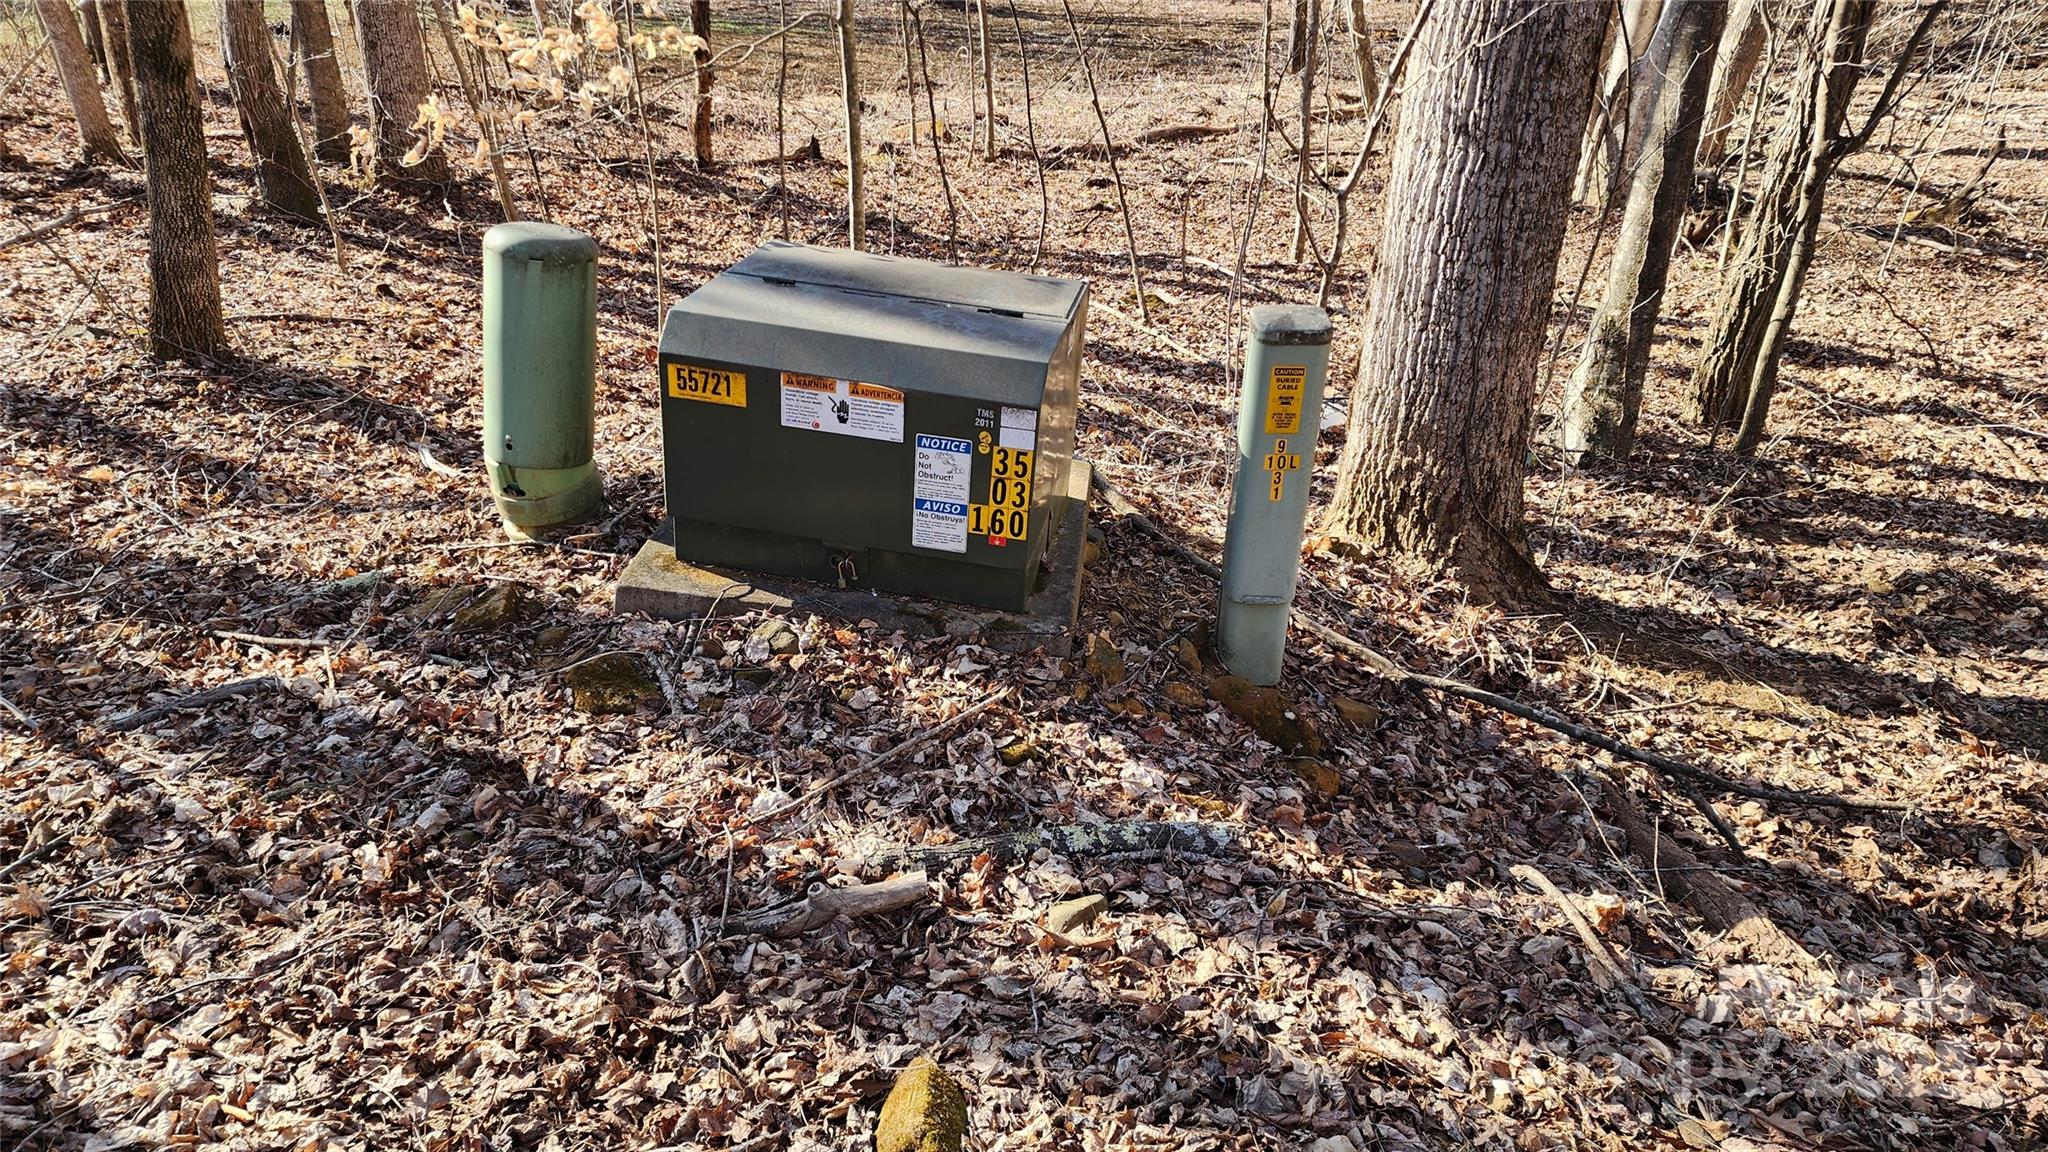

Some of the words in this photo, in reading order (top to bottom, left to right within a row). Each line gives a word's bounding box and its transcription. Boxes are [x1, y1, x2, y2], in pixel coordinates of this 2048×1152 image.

[676, 368, 731, 397] 55721
[795, 379, 834, 391] WARNING
[860, 388, 902, 401] ADVERTENCIA
[977, 408, 995, 419] TMS
[975, 418, 994, 428] 2011
[921, 437, 967, 453] NOTICE
[918, 453, 930, 461] Do
[918, 462, 932, 470] Not
[918, 471, 954, 481] Obstruct!
[923, 501, 961, 514] AVISO
[930, 513, 966, 524] Obstruya!
